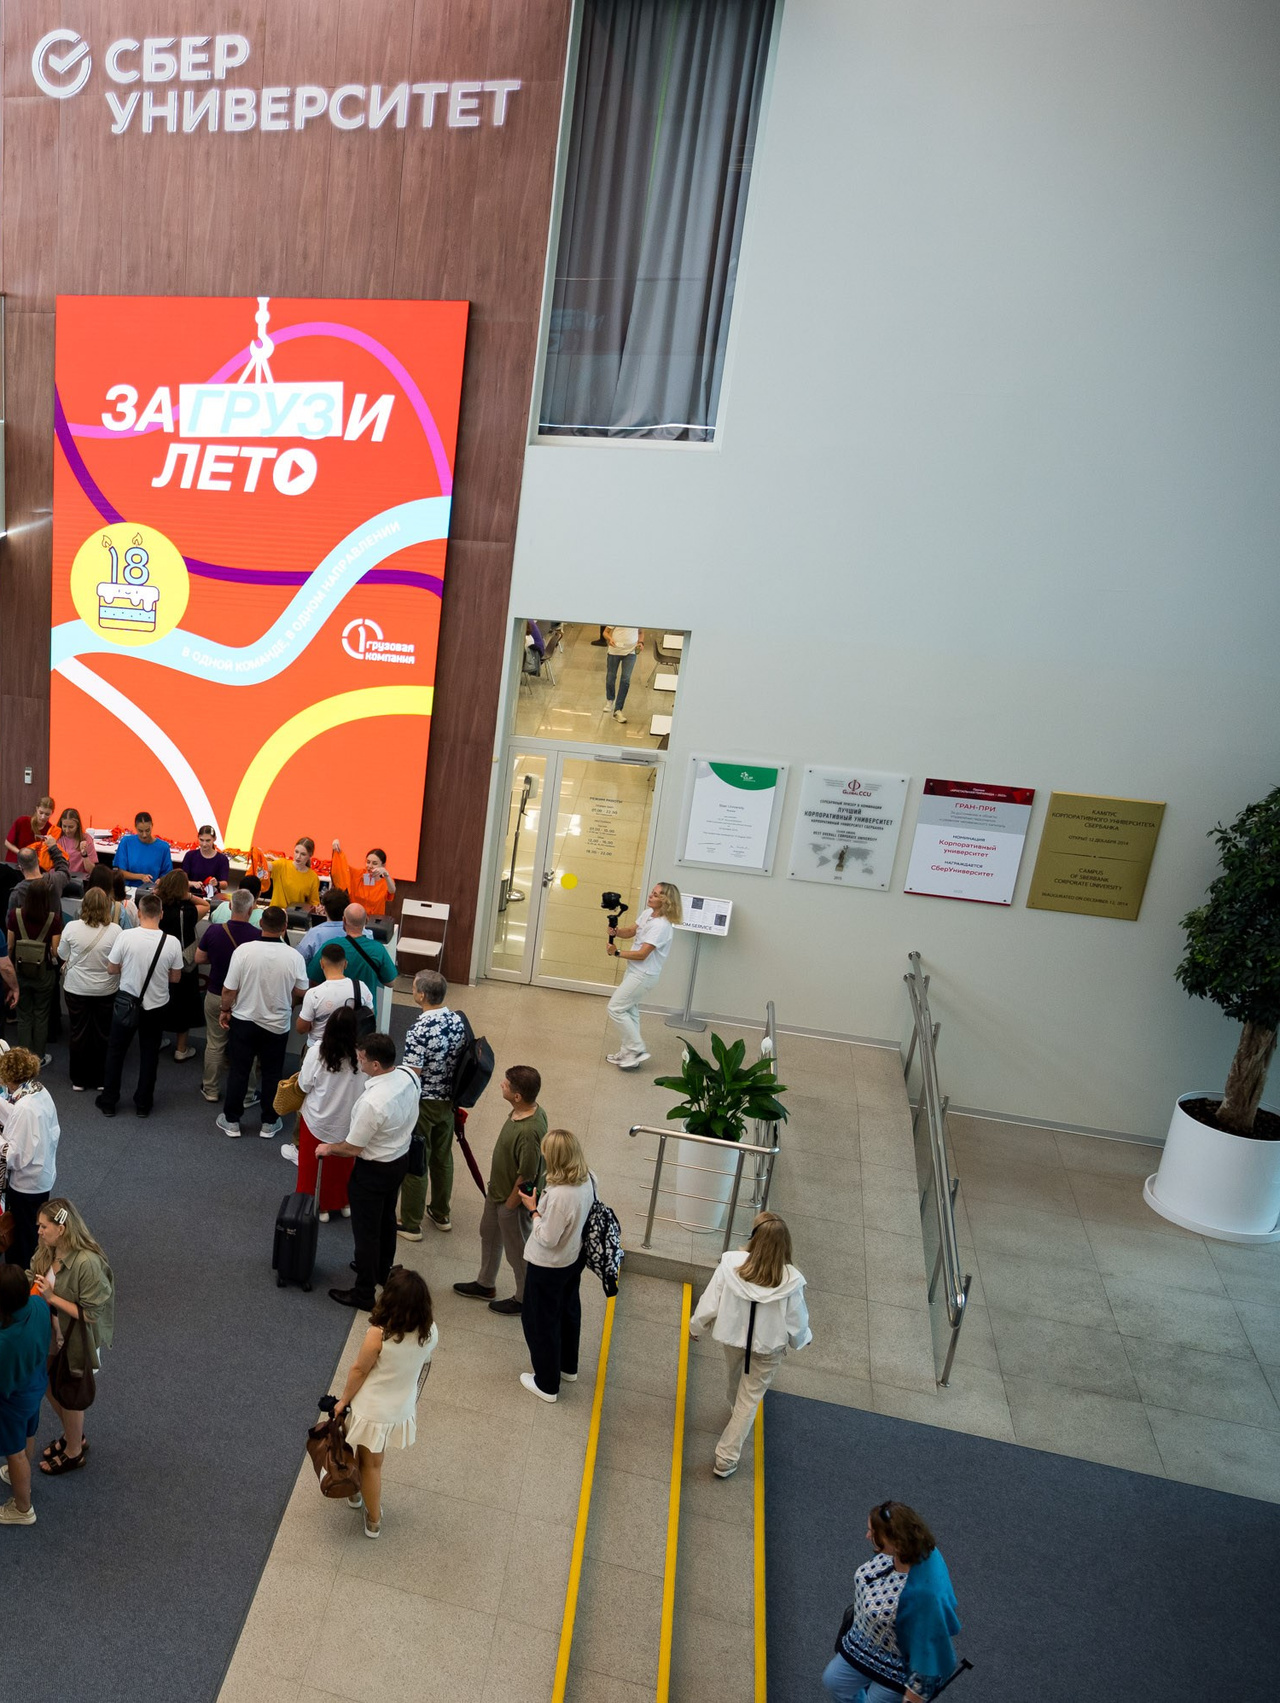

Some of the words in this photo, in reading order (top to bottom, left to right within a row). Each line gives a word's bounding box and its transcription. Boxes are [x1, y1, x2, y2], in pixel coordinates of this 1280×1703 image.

[105, 34, 250, 84] СБЕР
[105, 80, 521, 134] УНИВЕРСИТЕТ
[101, 383, 395, 442] ЗАГРУЗИ
[151, 443, 318, 496] ЛЕТО
[108, 546, 150, 585] 18
[181, 646, 190, 657] В
[192, 651, 233, 672] ОДНОЙ
[234, 640, 290, 672] КОМАНДЕ,
[285, 630, 295, 640] В
[292, 591, 326, 631] ОДНОМ
[321, 521, 400, 596] НАПРАВЛЕНИИ
[366, 641, 415, 653] грузовая
[365, 652, 415, 664] компания
[954, 802, 996, 812] ГРАН-ПРИ
[804, 810, 852, 821] КОРПОРАТИВНЫЙ
[854, 816, 893, 826] УНИВЕРСИТЕТ
[1052, 812, 1108, 823] КОРПОРАТИВНОГО
[1110, 818, 1155, 828] УНИВЕРСИТЕТА
[1084, 822, 1119, 831] СБЕРБАНКА
[939, 840, 996, 851] Корпоративный
[944, 848, 988, 858] университет
[930, 865, 994, 878] СберУниверситет
[1054, 878, 1089, 887] CORPORATE
[1090, 882, 1122, 890] UNIVERSITY
